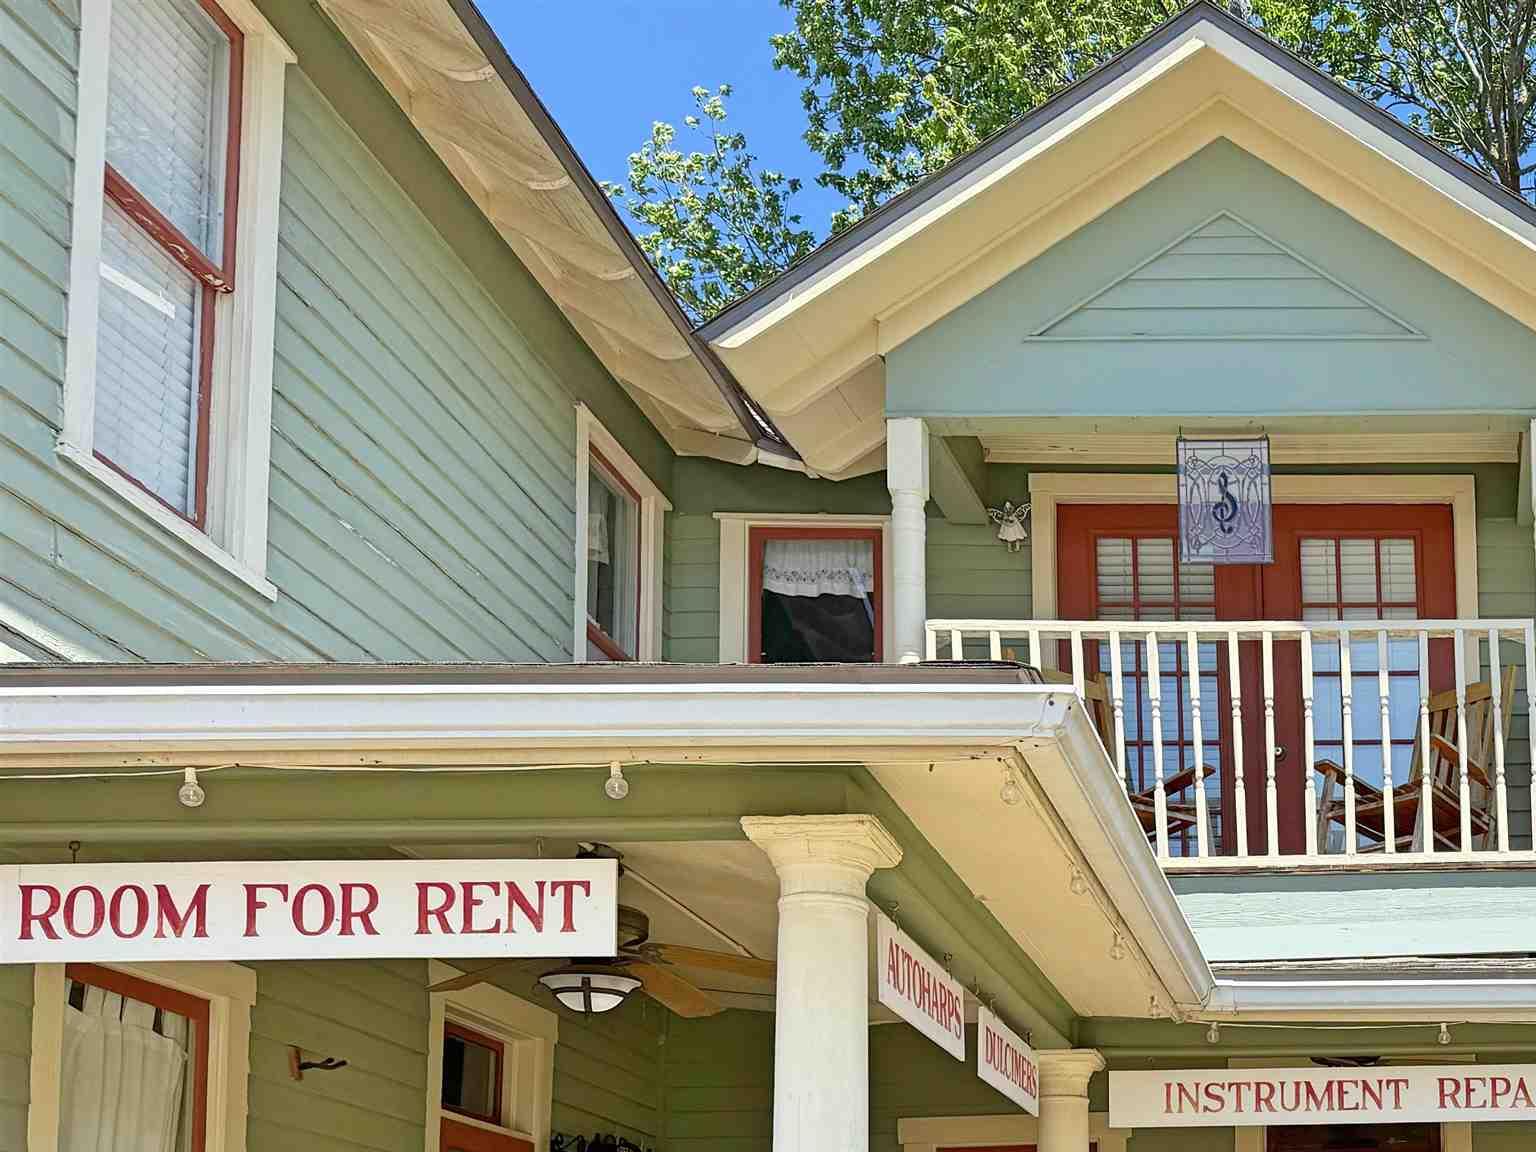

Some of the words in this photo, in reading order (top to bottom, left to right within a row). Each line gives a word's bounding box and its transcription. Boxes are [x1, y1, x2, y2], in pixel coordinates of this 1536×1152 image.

[18, 883, 211, 940] ROOM
[242, 882, 380, 937] FOR
[414, 879, 592, 936] RENT
[887, 936, 962, 1041] AUTOHARPS
[985, 1024, 1038, 1101] DULCIMERS
[1163, 1078, 1409, 1114] INSTRUMENT
